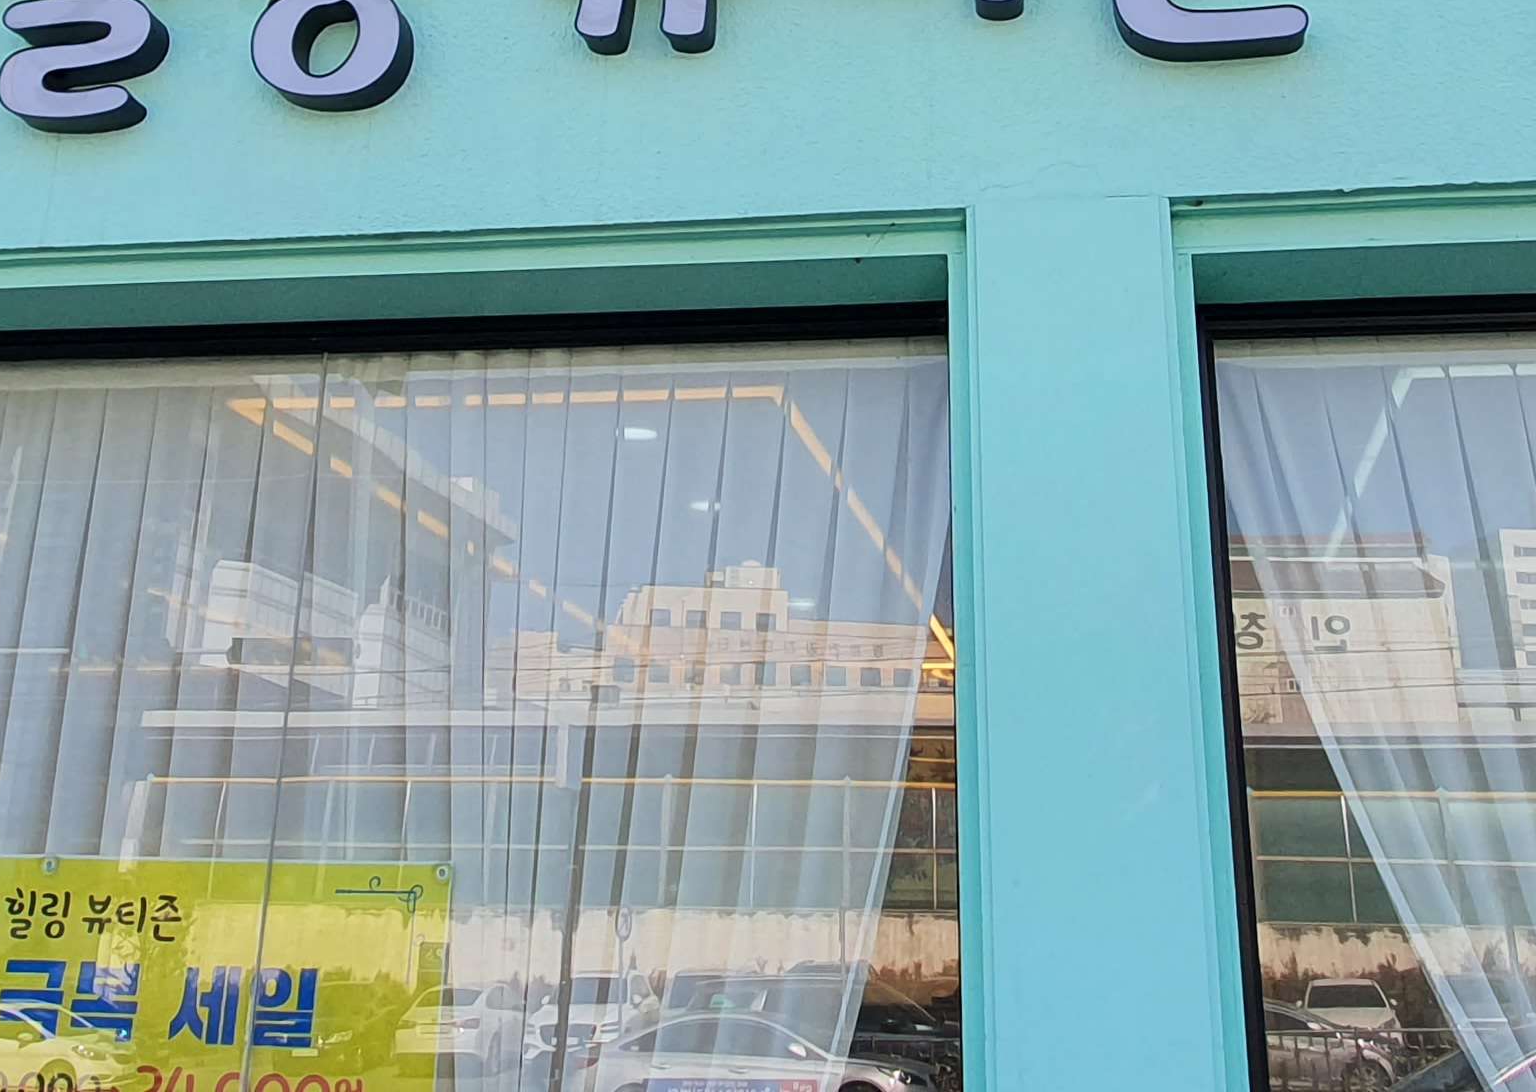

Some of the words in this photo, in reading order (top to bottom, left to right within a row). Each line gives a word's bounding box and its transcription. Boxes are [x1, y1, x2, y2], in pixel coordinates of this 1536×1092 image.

[5, 890, 73, 940] 힐링
[81, 893, 183, 944] 뷰티존
[168, 963, 320, 1049] 세일
